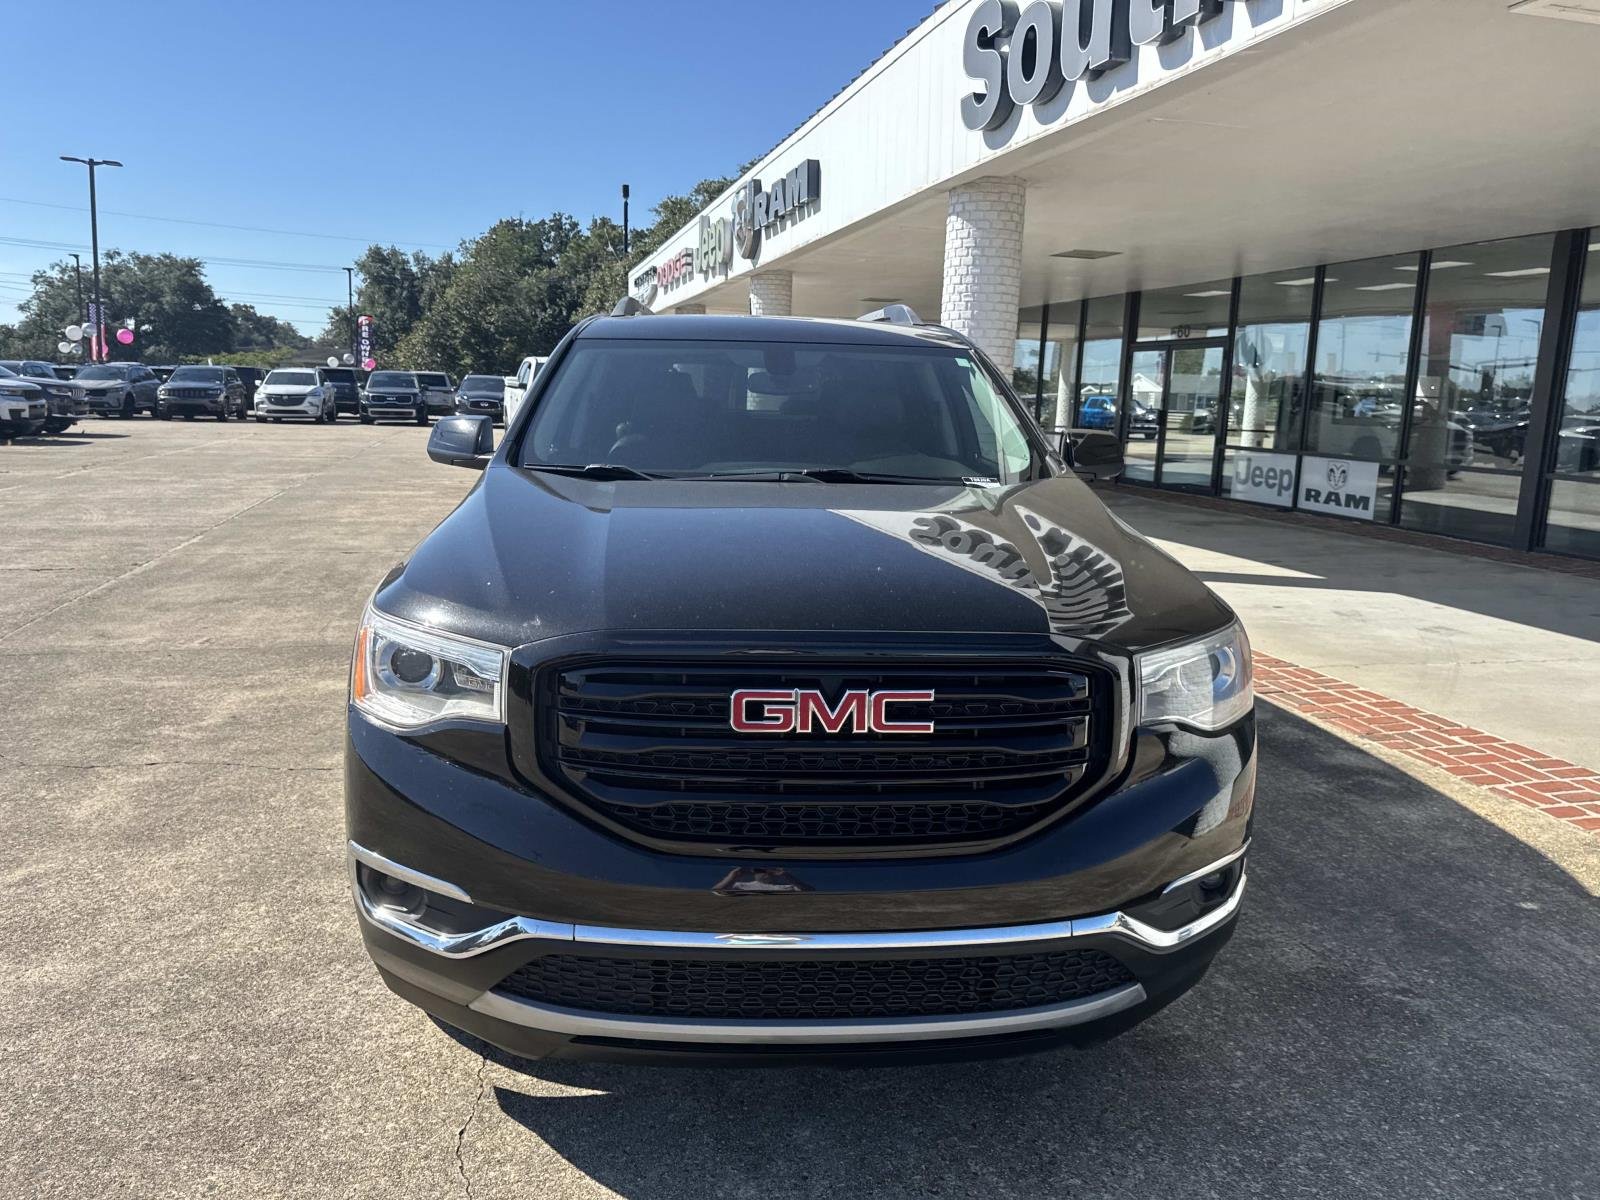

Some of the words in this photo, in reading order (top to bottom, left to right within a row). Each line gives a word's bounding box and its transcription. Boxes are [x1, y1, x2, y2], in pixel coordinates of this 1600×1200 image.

[961, 0, 1236, 131] Sou
[656, 248, 692, 288] DODGE
[695, 216, 730, 274] Jeep
[754, 159, 817, 230] RAM
[1235, 457, 1293, 496] Jeep
[1304, 488, 1370, 511] RAM
[730, 687, 935, 733] GMC
